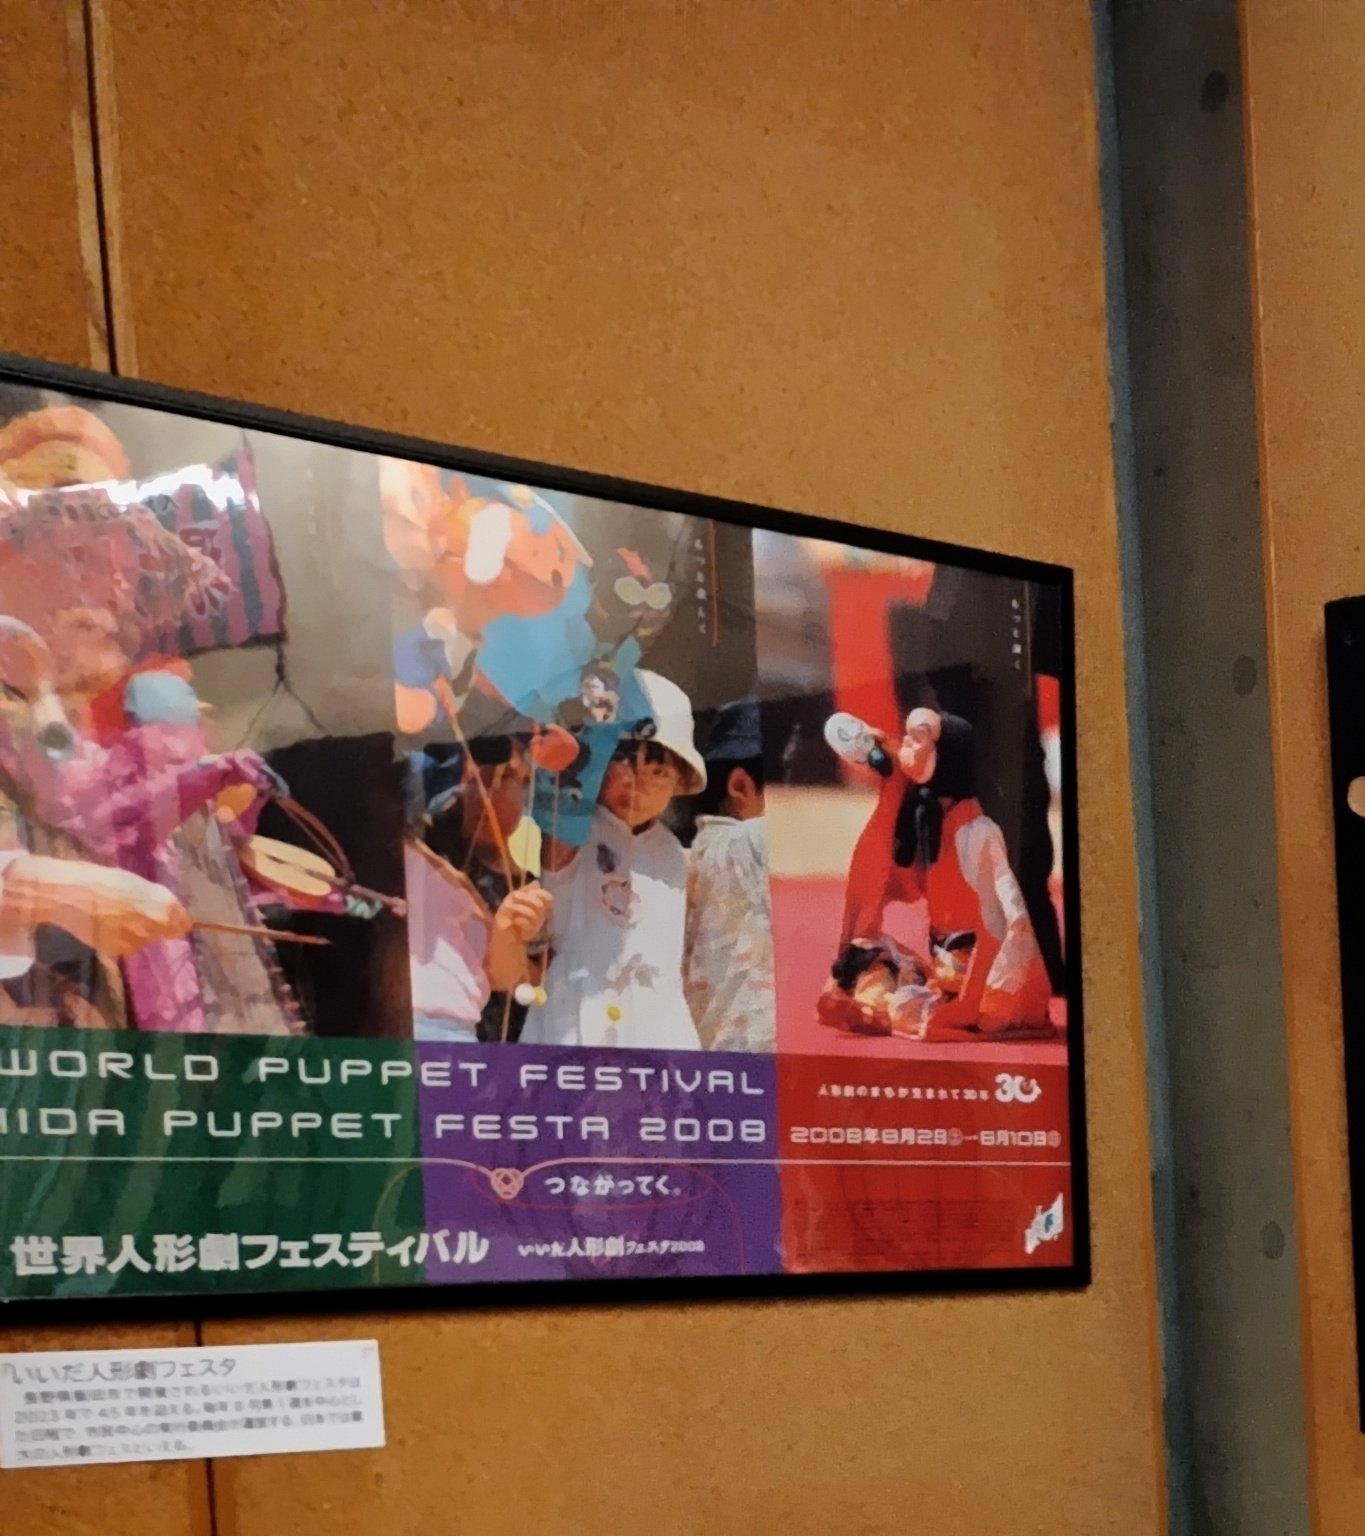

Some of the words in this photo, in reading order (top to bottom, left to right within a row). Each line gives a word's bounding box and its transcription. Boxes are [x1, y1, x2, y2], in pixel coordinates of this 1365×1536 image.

[0, 1049, 219, 1082] WORLD
[257, 1057, 488, 1088] PUPPET
[519, 1064, 766, 1095] FESTIVAL
[163, 1110, 403, 1139] PUPPET
[434, 1114, 610, 1140] FESTA
[638, 1117, 767, 1143] 2008
[544, 1174, 682, 1197] つながってく。
[10, 1229, 490, 1276] 世界人形劇フェスティバル
[12, 1358, 236, 1385] いいだ人形劇フェスタ
